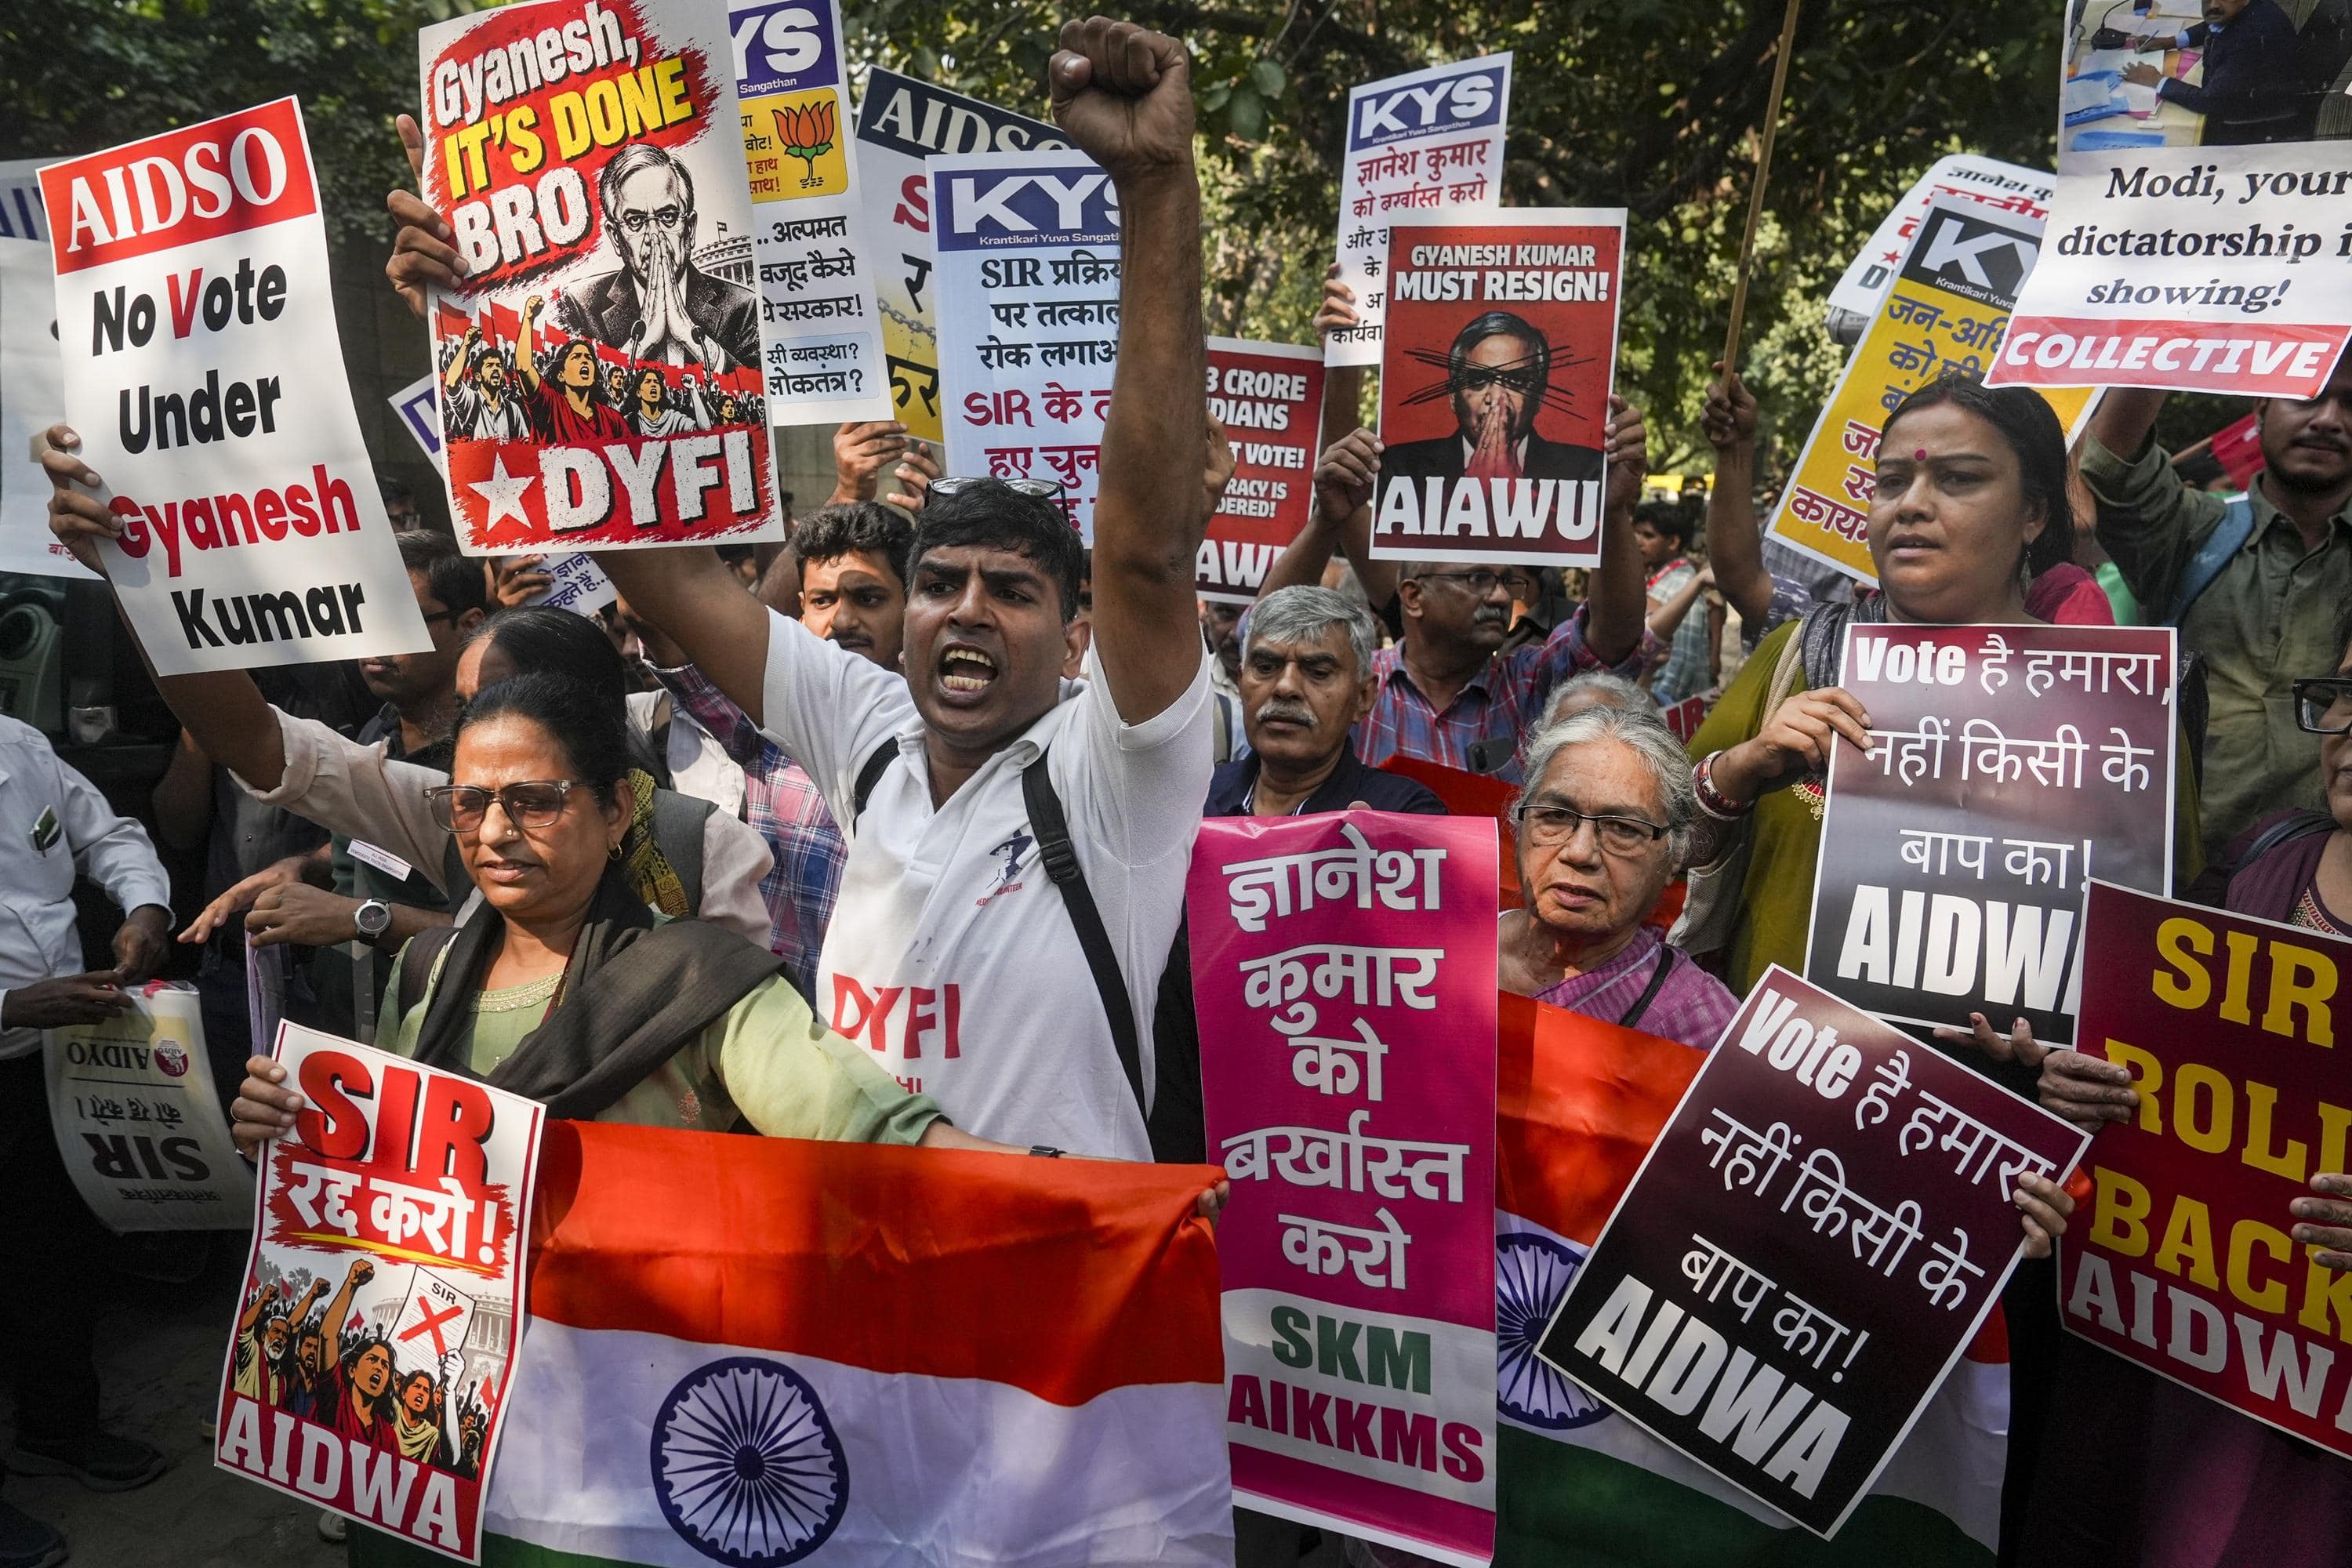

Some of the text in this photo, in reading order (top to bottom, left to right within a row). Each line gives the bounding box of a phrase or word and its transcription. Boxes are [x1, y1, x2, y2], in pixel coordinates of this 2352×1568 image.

[432, 6, 642, 127] Gyanesh,
[731, 7, 822, 80] YS
[739, 78, 797, 93] Sangathan
[1359, 75, 1494, 140] KYS
[444, 57, 695, 200] IT'S DONE
[67, 127, 287, 253] AIDSO
[1357, 140, 1491, 187] ज्ञानेश कुमार
[2105, 165, 2352, 205] Modi, your
[451, 166, 592, 280] BRO
[1353, 191, 1375, 218] को
[1449, 173, 1489, 204] करो
[772, 216, 848, 243] अल्पमत
[979, 231, 1120, 245] Krantikari Yuva Sangat
[1345, 226, 1375, 249] और
[1410, 245, 1595, 267] GYANESH KUMAR
[2057, 222, 2352, 264] dictatorship i
[807, 247, 856, 278] कैसे
[981, 257, 1044, 289] SIR
[1364, 256, 1381, 278] के
[1921, 217, 2042, 299] KY
[93, 257, 287, 358] No Vote
[776, 293, 864, 321] सरकार!
[1395, 271, 1478, 302] MUST
[1483, 270, 1608, 303] RESIGN!
[1935, 276, 1988, 301] Krantikari
[2087, 278, 2291, 313] showing!
[989, 303, 1031, 328] पर
[1331, 321, 1382, 345] कार्यवा
[766, 343, 787, 364] सी
[976, 335, 1033, 370] रोक
[1889, 339, 1938, 378] को
[2004, 332, 2330, 378] COLLECTIVE
[120, 369, 281, 455] Under
[963, 389, 1036, 427] SIR
[1041, 382, 1083, 424] के
[1224, 368, 1307, 401] CRORE
[1207, 397, 1289, 430] DIANS
[537, 430, 760, 533] DYFI
[1039, 445, 1101, 490] चुन
[1228, 441, 1305, 469] T VOTE!
[1216, 497, 1276, 518] DERED!
[1225, 478, 1287, 499] RACY IS
[1374, 475, 1600, 541] AIAWU
[108, 464, 360, 578] Gyanesh
[172, 583, 365, 649] Kumar
[1856, 633, 2172, 706] Vote है हमारा,
[1667, 696, 1705, 746] IR
[1864, 717, 2154, 792] नहीं किसी के
[1222, 822, 1447, 933] ज्ञानेश
[1900, 829, 2092, 892] बाप का!
[1836, 884, 2082, 1017] AIDW
[1240, 944, 1446, 1036] कुमार
[2151, 917, 2339, 1049] SIR
[831, 972, 960, 1059] DYFI
[67, 1042, 150, 1069] AIDYO
[1289, 1018, 1389, 1101] को
[1738, 989, 1863, 1100] Vote
[1855, 1050, 1912, 1130] है
[297, 1051, 495, 1187] SIR
[80, 1133, 210, 1181] SIR
[1221, 1109, 1472, 1204] बर्खास्त
[1701, 1107, 1985, 1311] नहीं किसी के
[1278, 1207, 1412, 1291] करो
[431, 1283, 456, 1305] SIR
[1679, 1232, 1871, 1385] बाप का!
[1272, 1305, 1432, 1396] SKM
[2068, 1252, 2352, 1434] AIDW
[1573, 1273, 1852, 1501] AIDWA
[1228, 1373, 1486, 1484] AIKKMS
[220, 1399, 461, 1552] AIDWA
